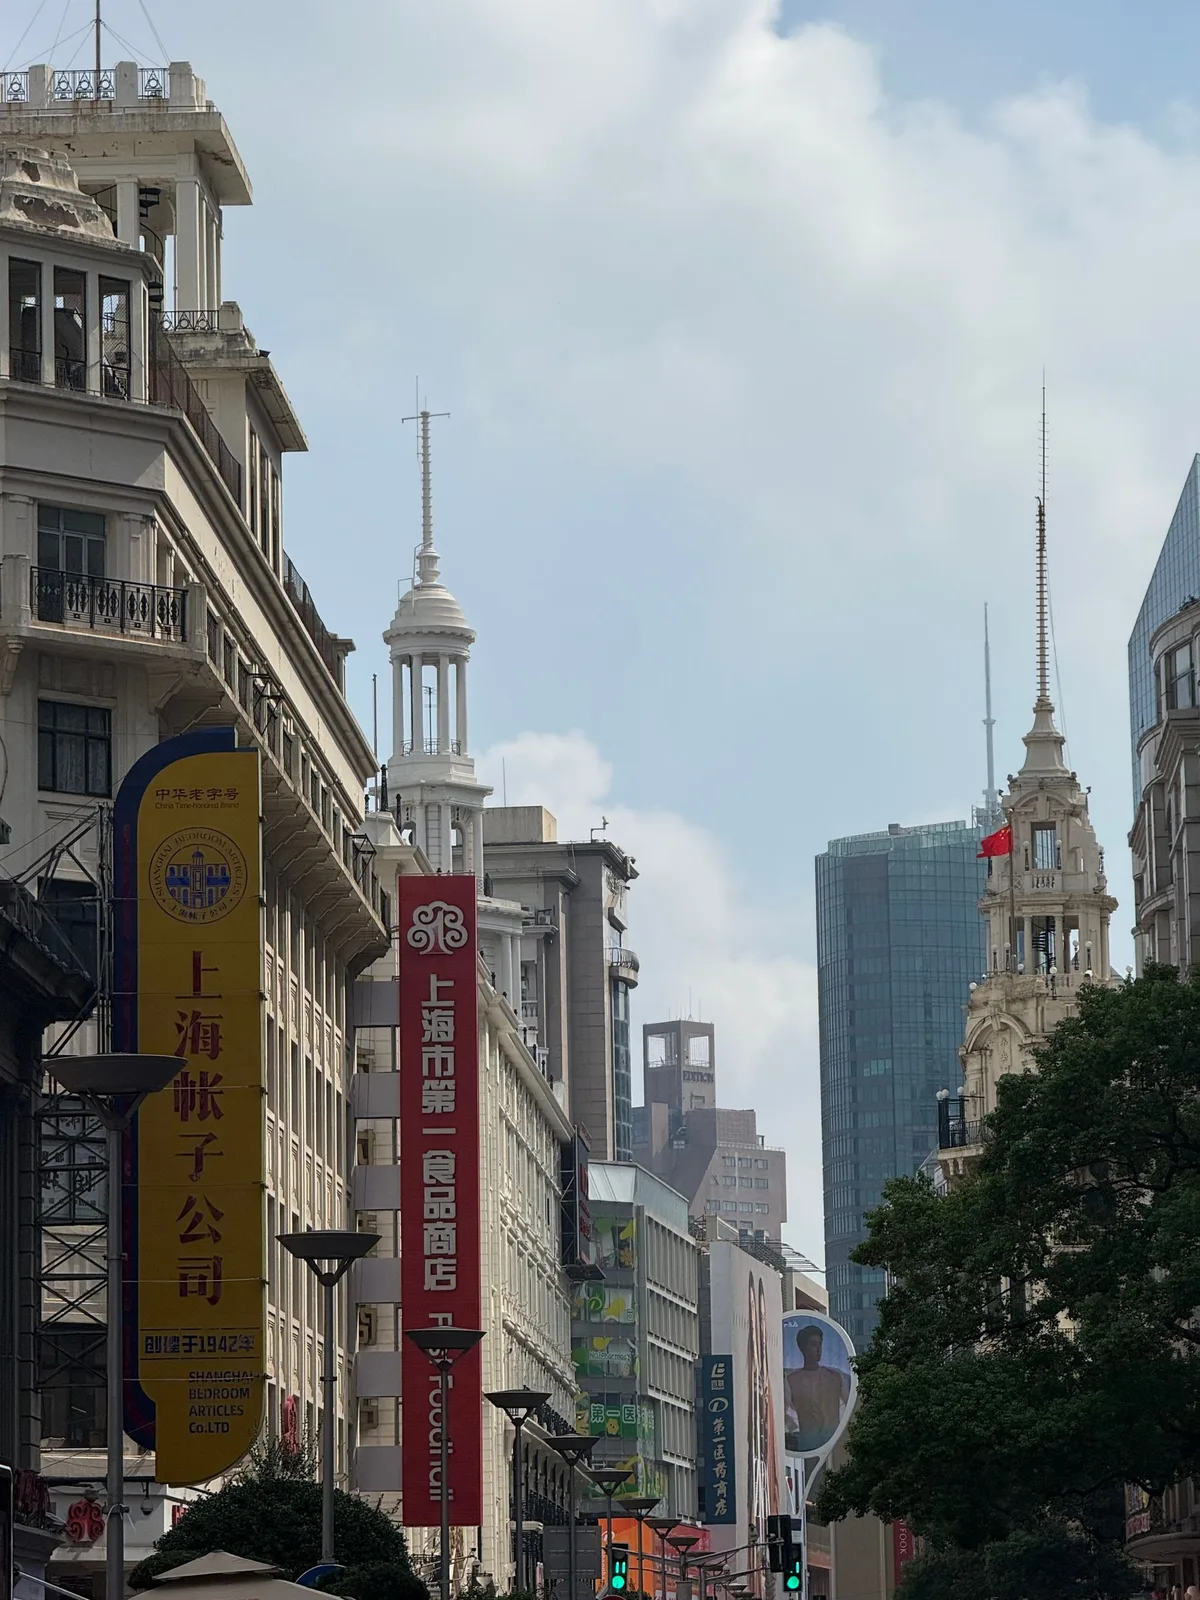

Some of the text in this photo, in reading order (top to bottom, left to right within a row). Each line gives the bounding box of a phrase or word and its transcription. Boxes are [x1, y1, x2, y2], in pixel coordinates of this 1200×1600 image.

[155, 788, 239, 801] 中华老字号
[153, 832, 243, 898] SHANGHAI BEDROOM ARTICLES
[682, 1070, 714, 1083] EDITION
[174, 950, 224, 1306] 上海帐子公司
[421, 973, 457, 1291] 上海市第一食品商店
[144, 1334, 255, 1354] 创建于1942年
[189, 1371, 254, 1383] SHANGHAI
[189, 1388, 250, 1400] BEDROOM
[189, 1405, 244, 1417] ARTICLES
[189, 1422, 230, 1434] Co.LTD
[898, 1528, 908, 1555] FOOK
